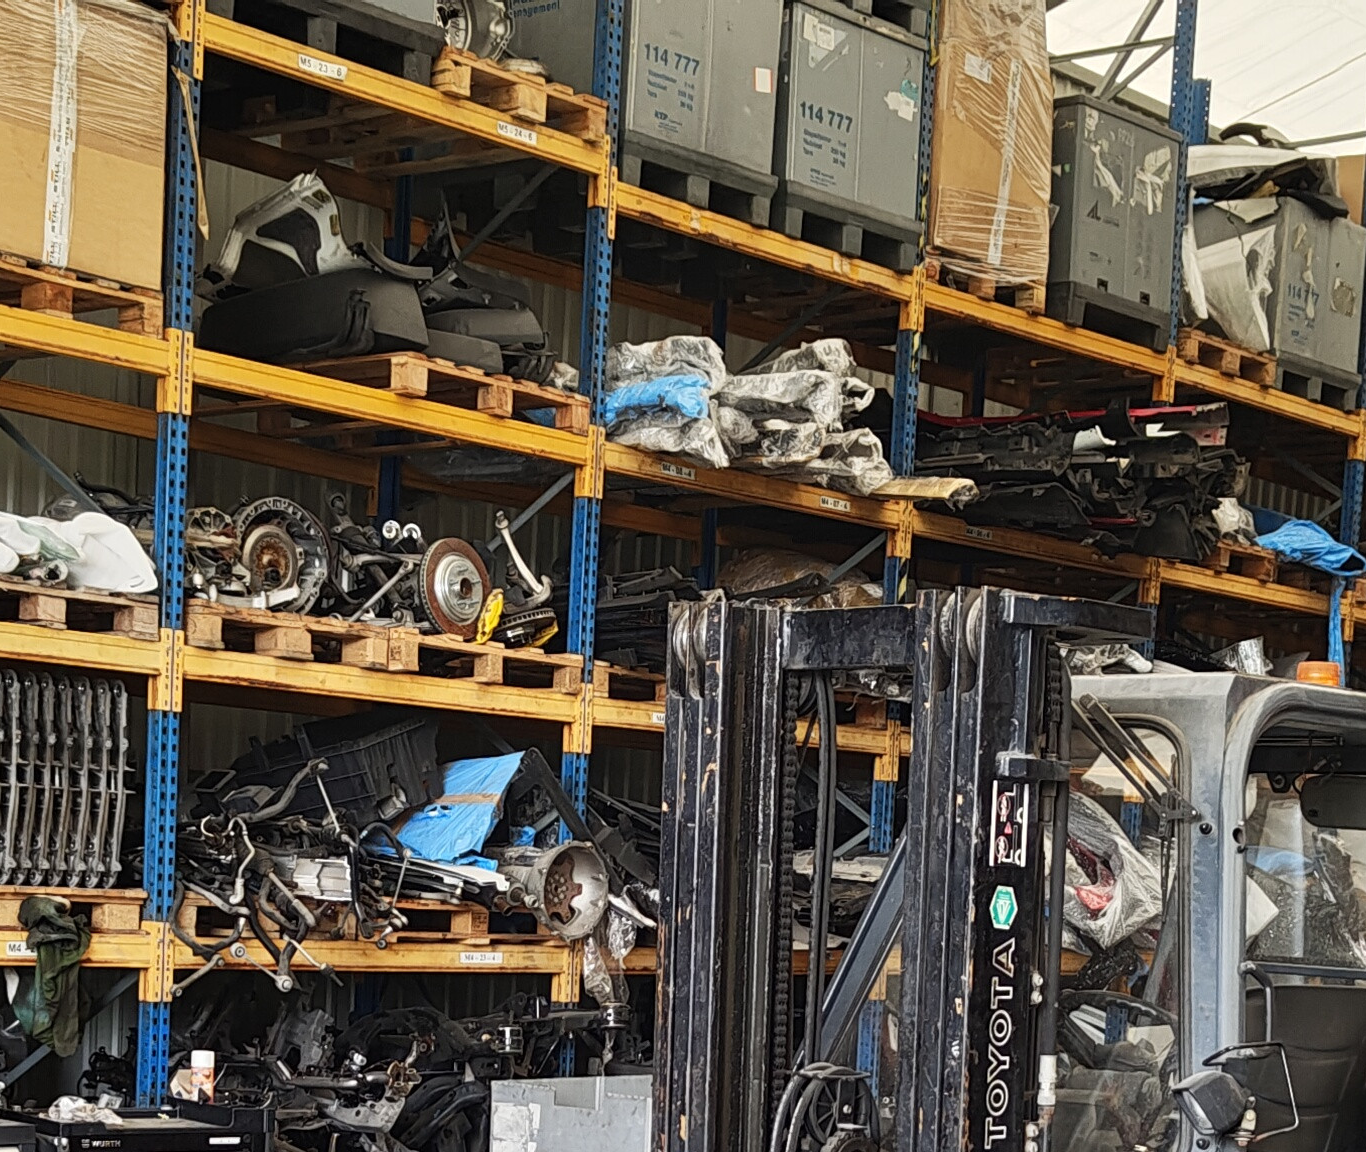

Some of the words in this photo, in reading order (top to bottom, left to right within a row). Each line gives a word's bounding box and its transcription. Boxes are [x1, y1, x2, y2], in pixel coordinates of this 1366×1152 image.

[644, 43, 669, 67] 114
[674, 51, 700, 76] 777
[800, 101, 824, 124] 114
[827, 108, 853, 133] 777
[8, 943, 21, 953] M4
[984, 937, 1016, 1150] TOYOTA
